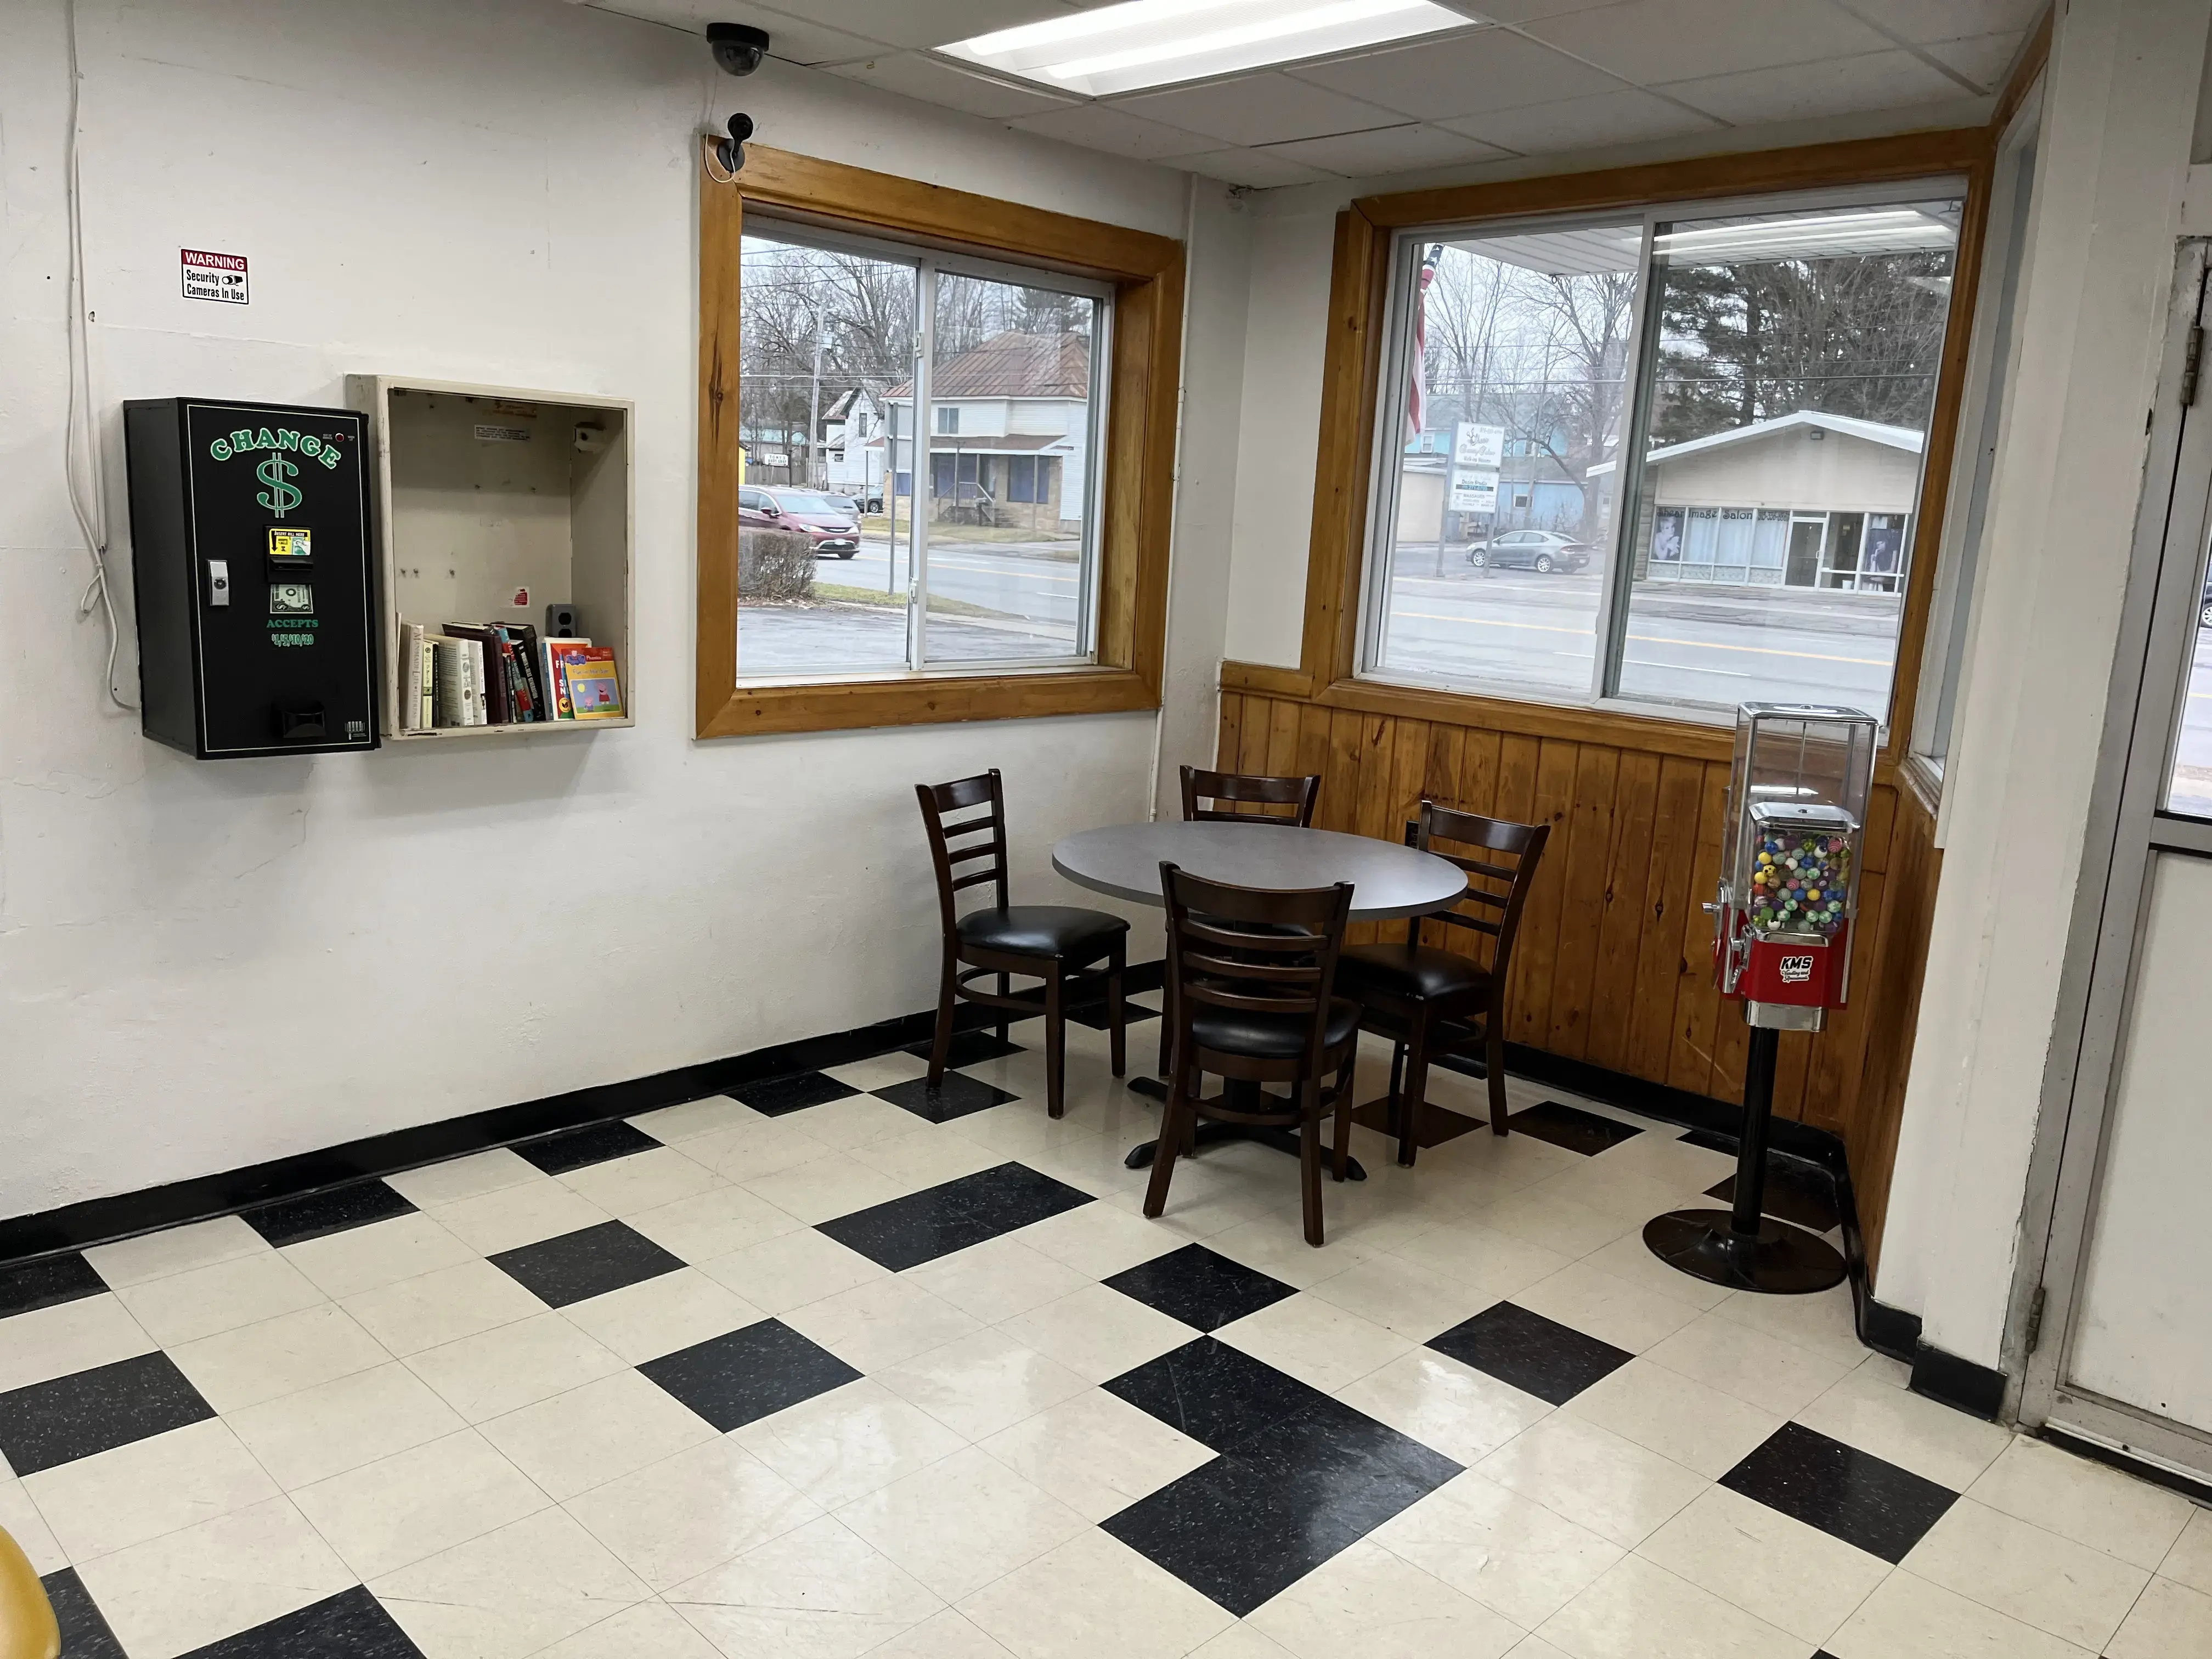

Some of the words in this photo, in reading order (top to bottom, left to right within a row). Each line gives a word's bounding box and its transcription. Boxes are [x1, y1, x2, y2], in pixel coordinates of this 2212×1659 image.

[185, 252, 245, 270] WARNING
[187, 269, 219, 286] Security
[187, 284, 219, 298] Cameras
[222, 287, 229, 299] In
[231, 289, 245, 301] Use
[210, 428, 341, 469] CHANGE
[1689, 508, 1718, 520] Image
[1723, 509, 1753, 520] Salon
[266, 619, 319, 628] ACCEPTS
[1781, 957, 1813, 969] KMS
